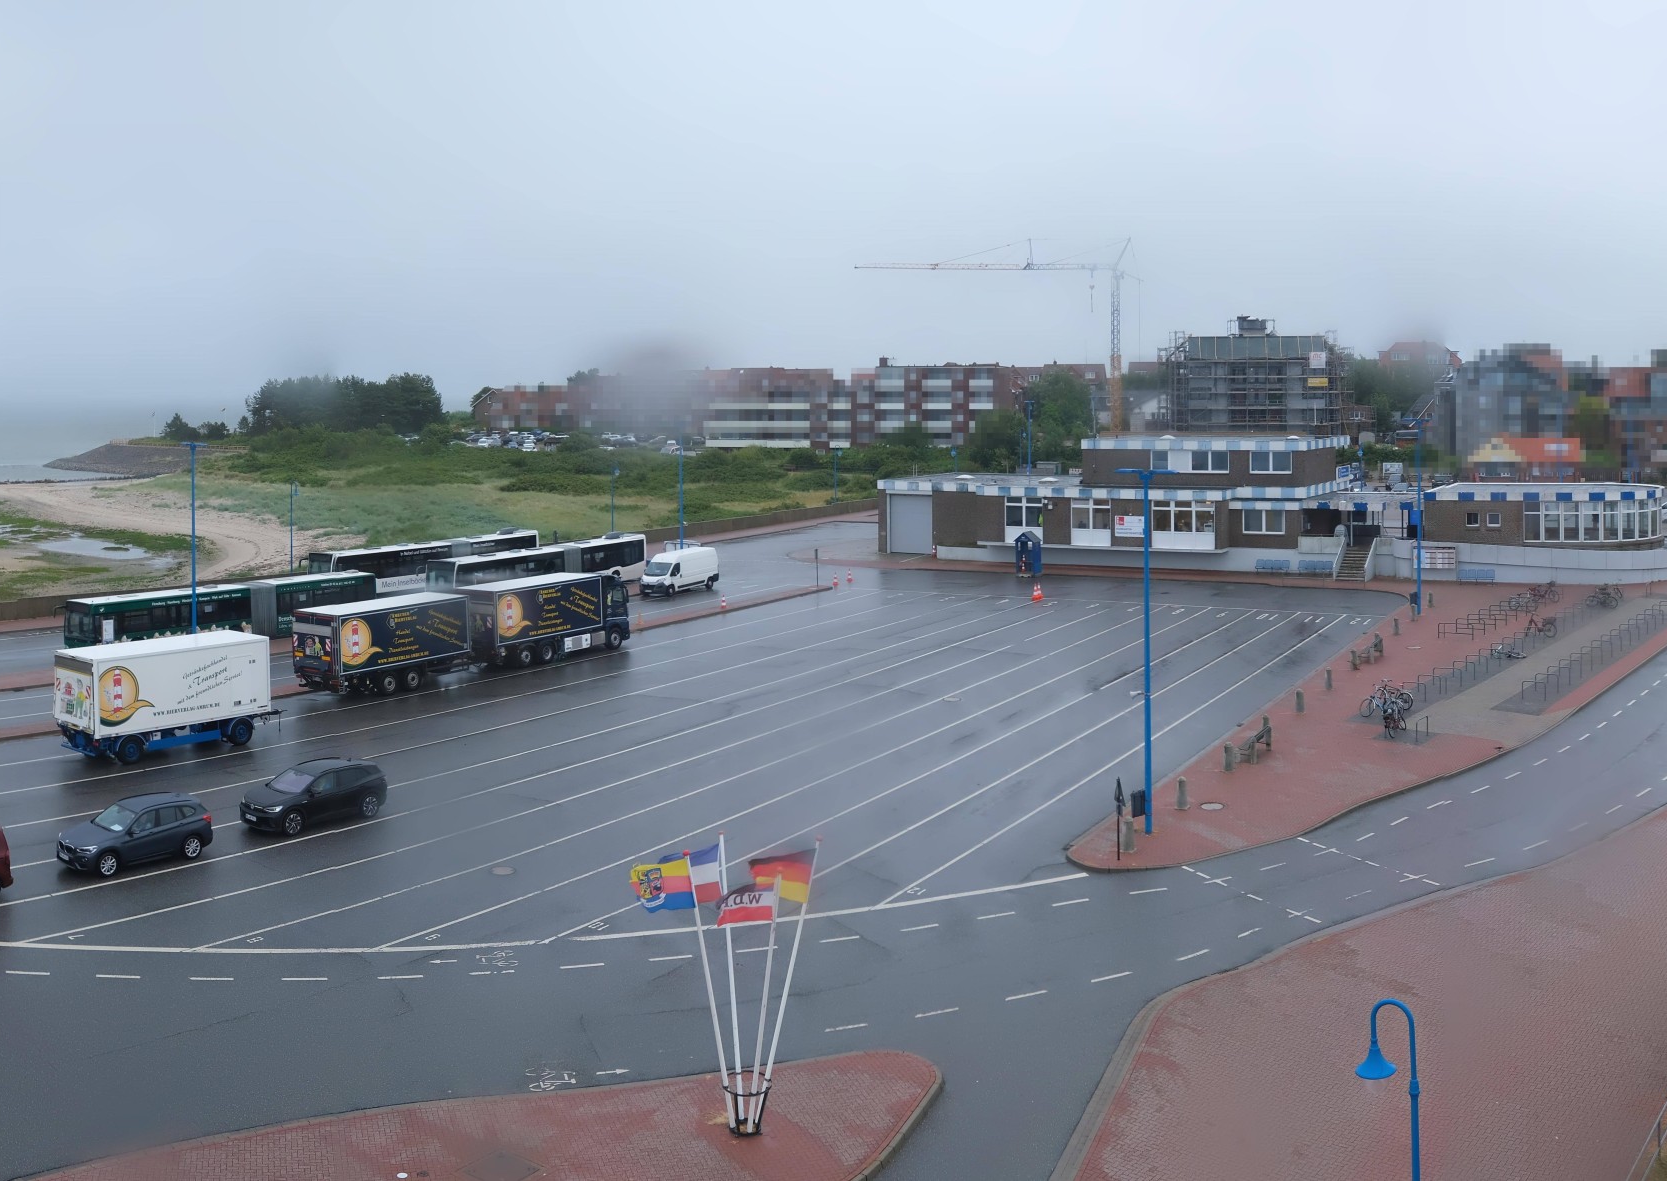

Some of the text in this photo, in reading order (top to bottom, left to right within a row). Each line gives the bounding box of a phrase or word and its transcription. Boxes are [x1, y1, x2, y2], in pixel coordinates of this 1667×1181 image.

[397, 576, 426, 586] Inselbäcke
[183, 655, 227, 680] Getränkefachhandel
[193, 666, 227, 686] Transport
[195, 680, 223, 699] freundlichen
[223, 671, 243, 684] Service!
